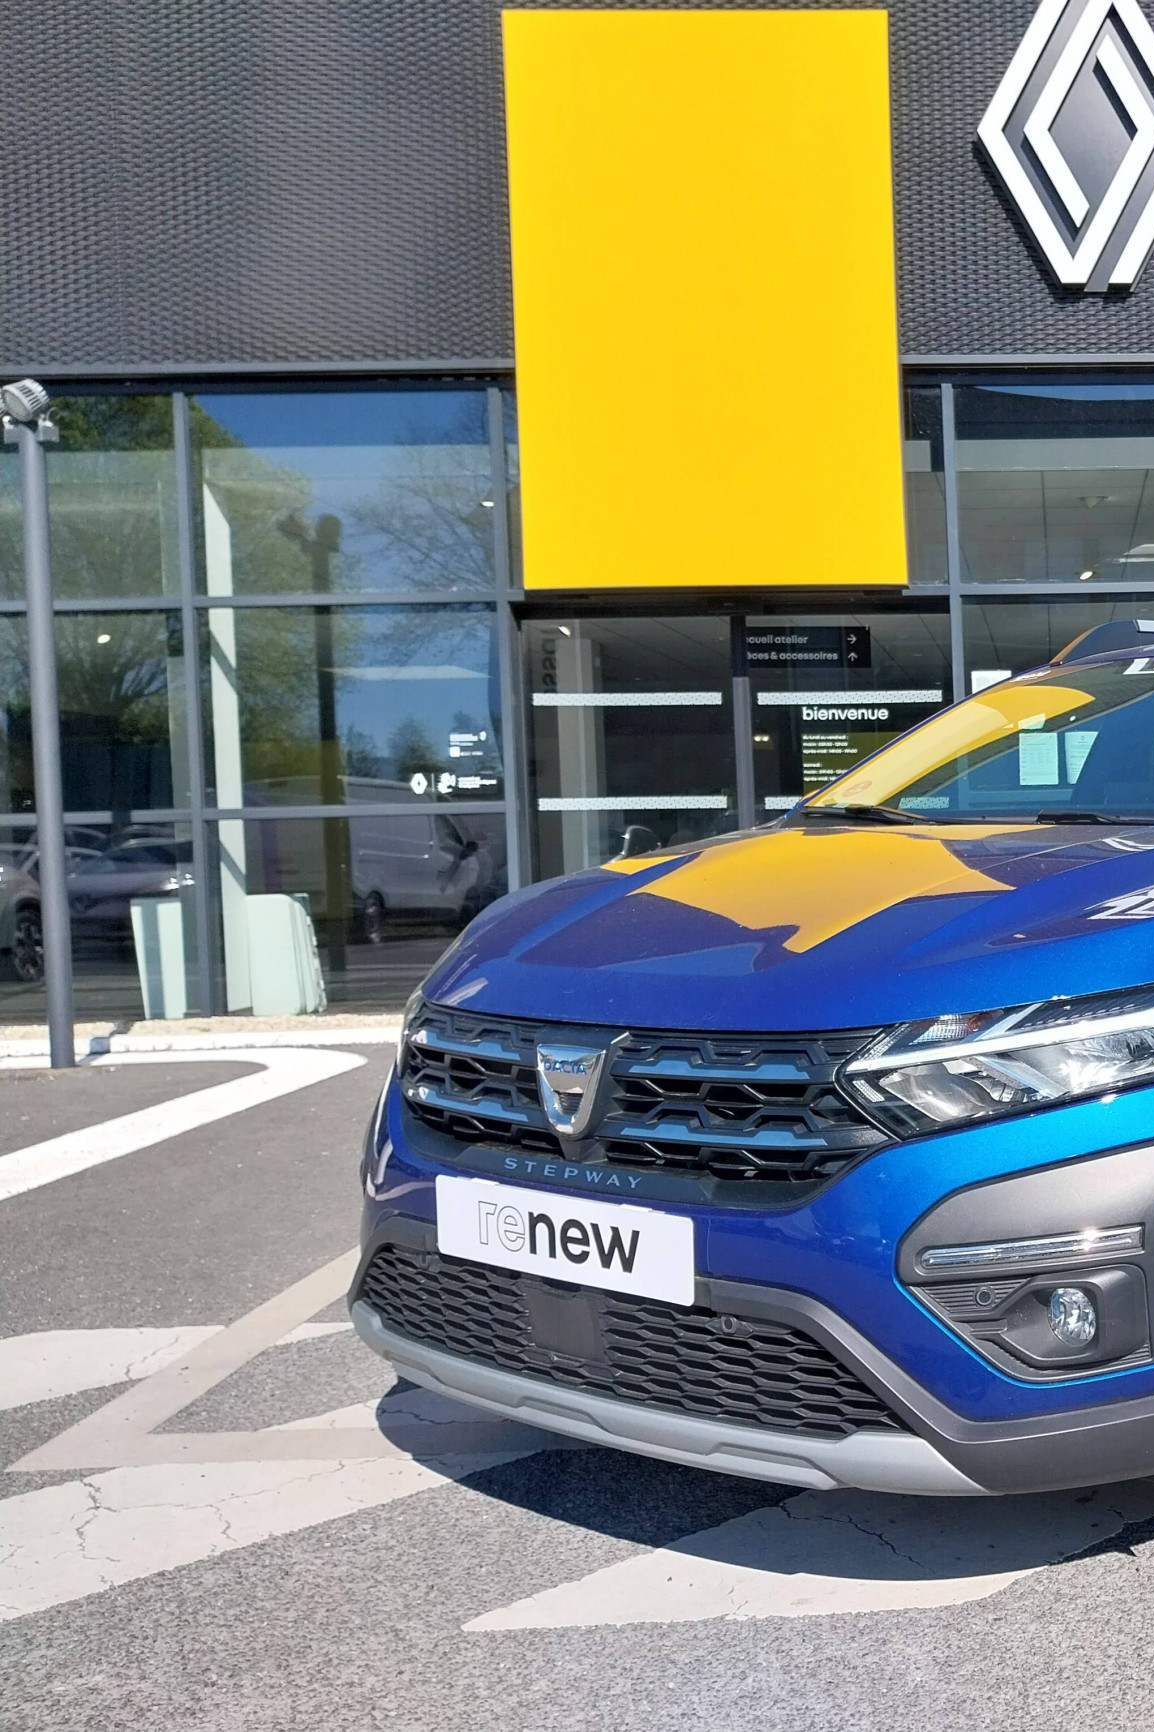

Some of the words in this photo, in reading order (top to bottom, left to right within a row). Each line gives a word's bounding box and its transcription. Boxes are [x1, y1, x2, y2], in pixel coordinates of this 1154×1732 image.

[746, 634, 773, 644] cueil
[774, 634, 808, 644] atelier
[770, 651, 778, 660] &
[779, 651, 838, 660] accessoires
[802, 706, 889, 721] bienvenue
[543, 1059, 587, 1076] DACIA
[504, 1157, 643, 1189] STEPWAY
[477, 1200, 640, 1275] renew
